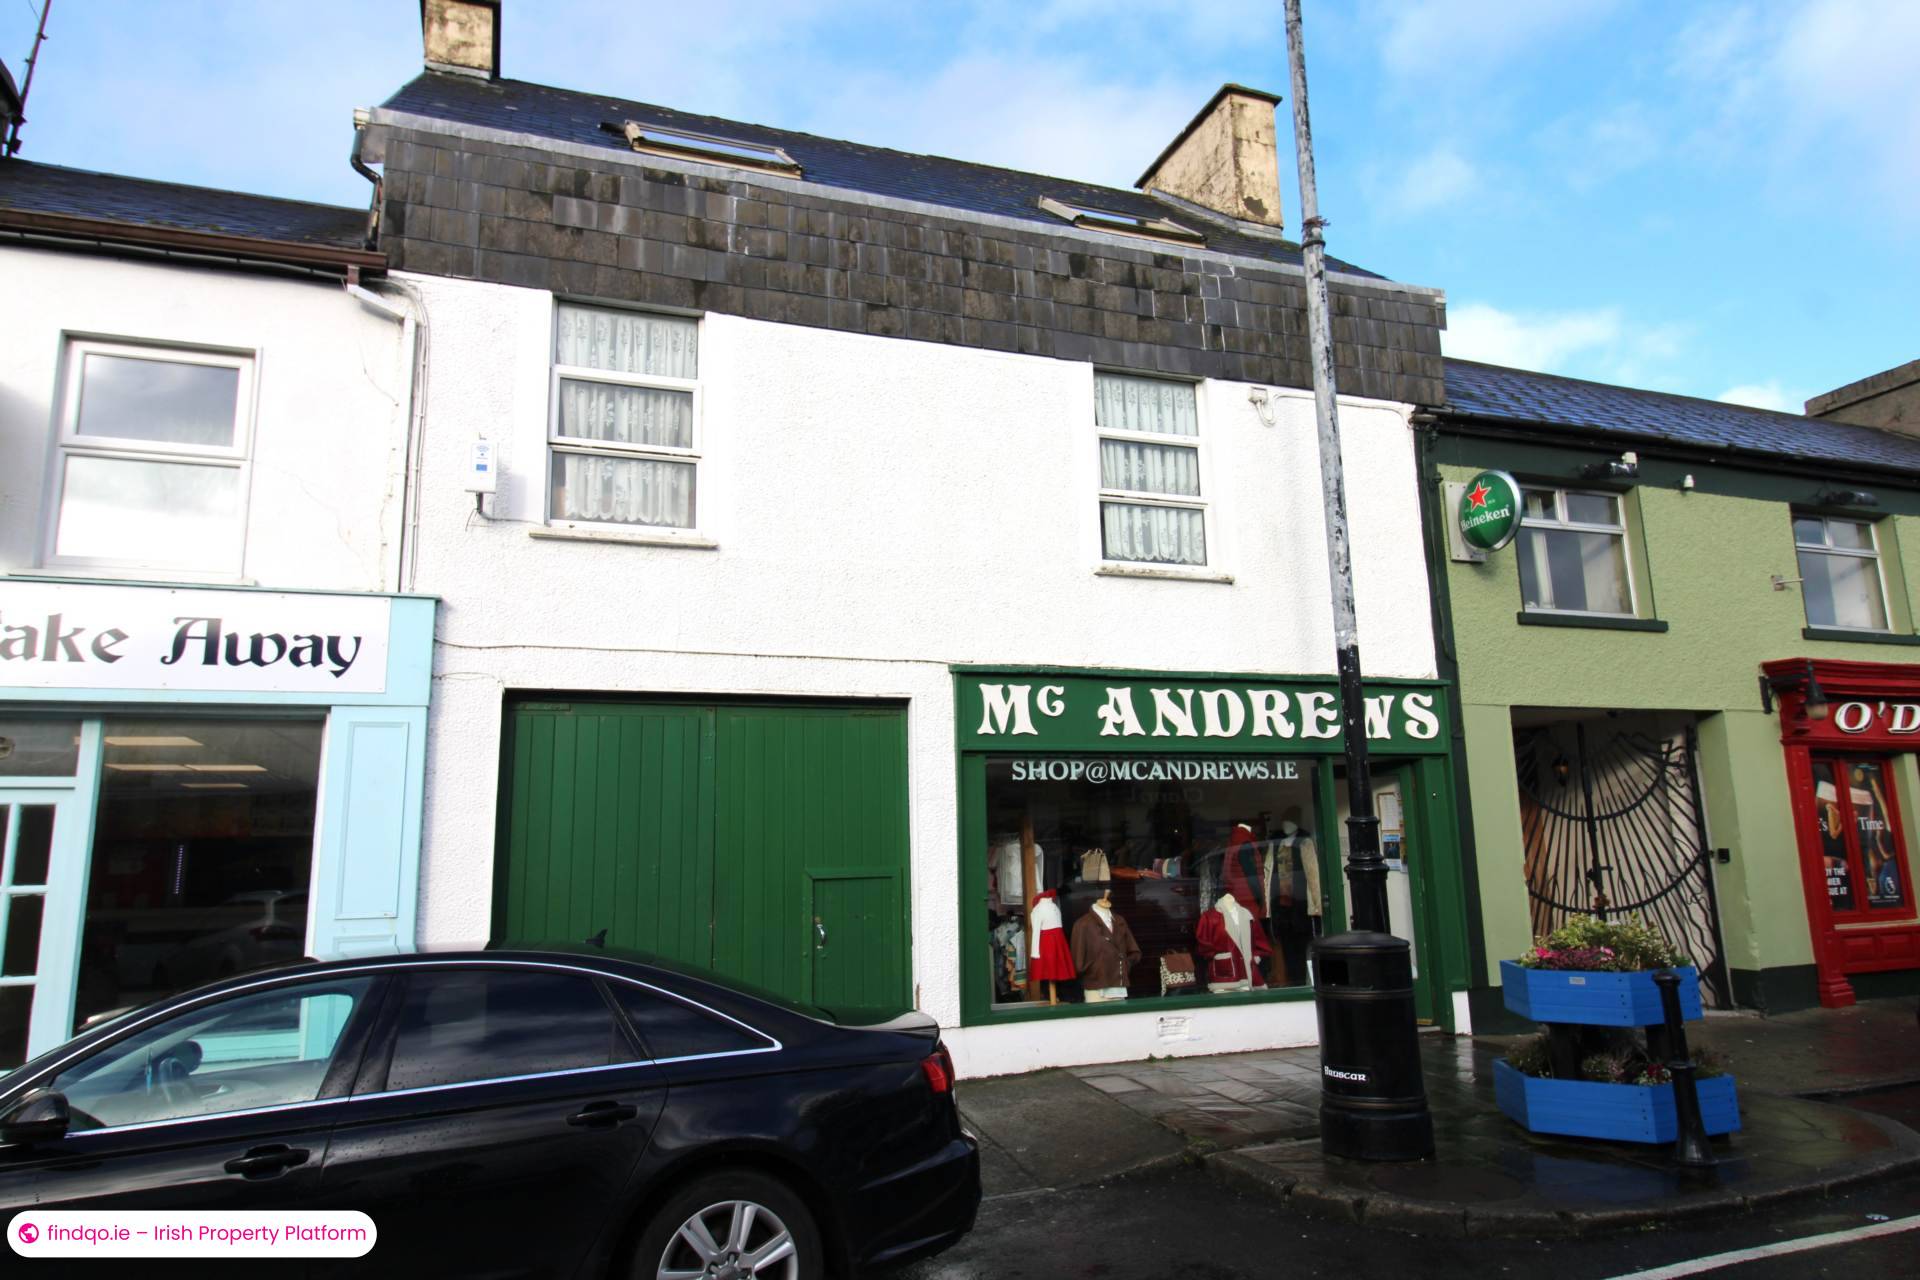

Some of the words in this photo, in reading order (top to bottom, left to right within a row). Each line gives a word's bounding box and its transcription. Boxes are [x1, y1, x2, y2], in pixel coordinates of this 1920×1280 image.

[1460, 507, 1510, 532] Heineken
[0, 610, 130, 664] ake
[160, 616, 363, 679] Away
[1011, 760, 1299, 784] SHOP@MCANDREWS.IE
[1857, 815, 1884, 831] Time
